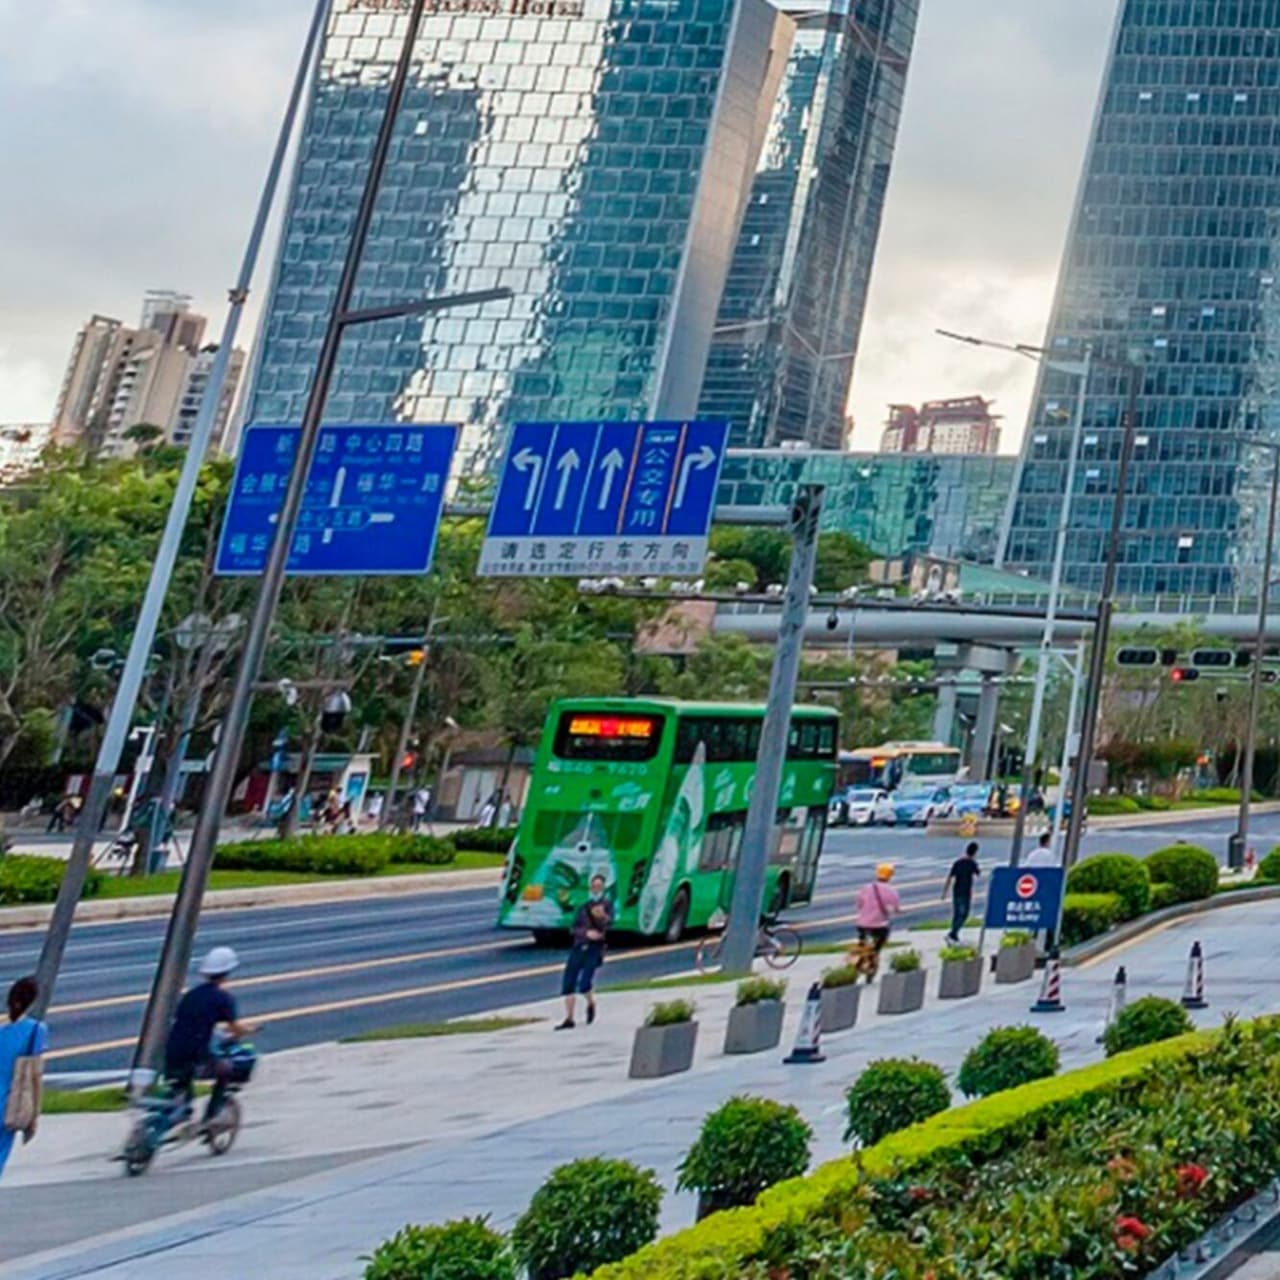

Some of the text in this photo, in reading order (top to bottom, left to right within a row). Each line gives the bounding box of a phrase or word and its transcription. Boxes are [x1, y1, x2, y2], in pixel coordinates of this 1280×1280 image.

[501, 541, 690, 560] 请选定行车方向
